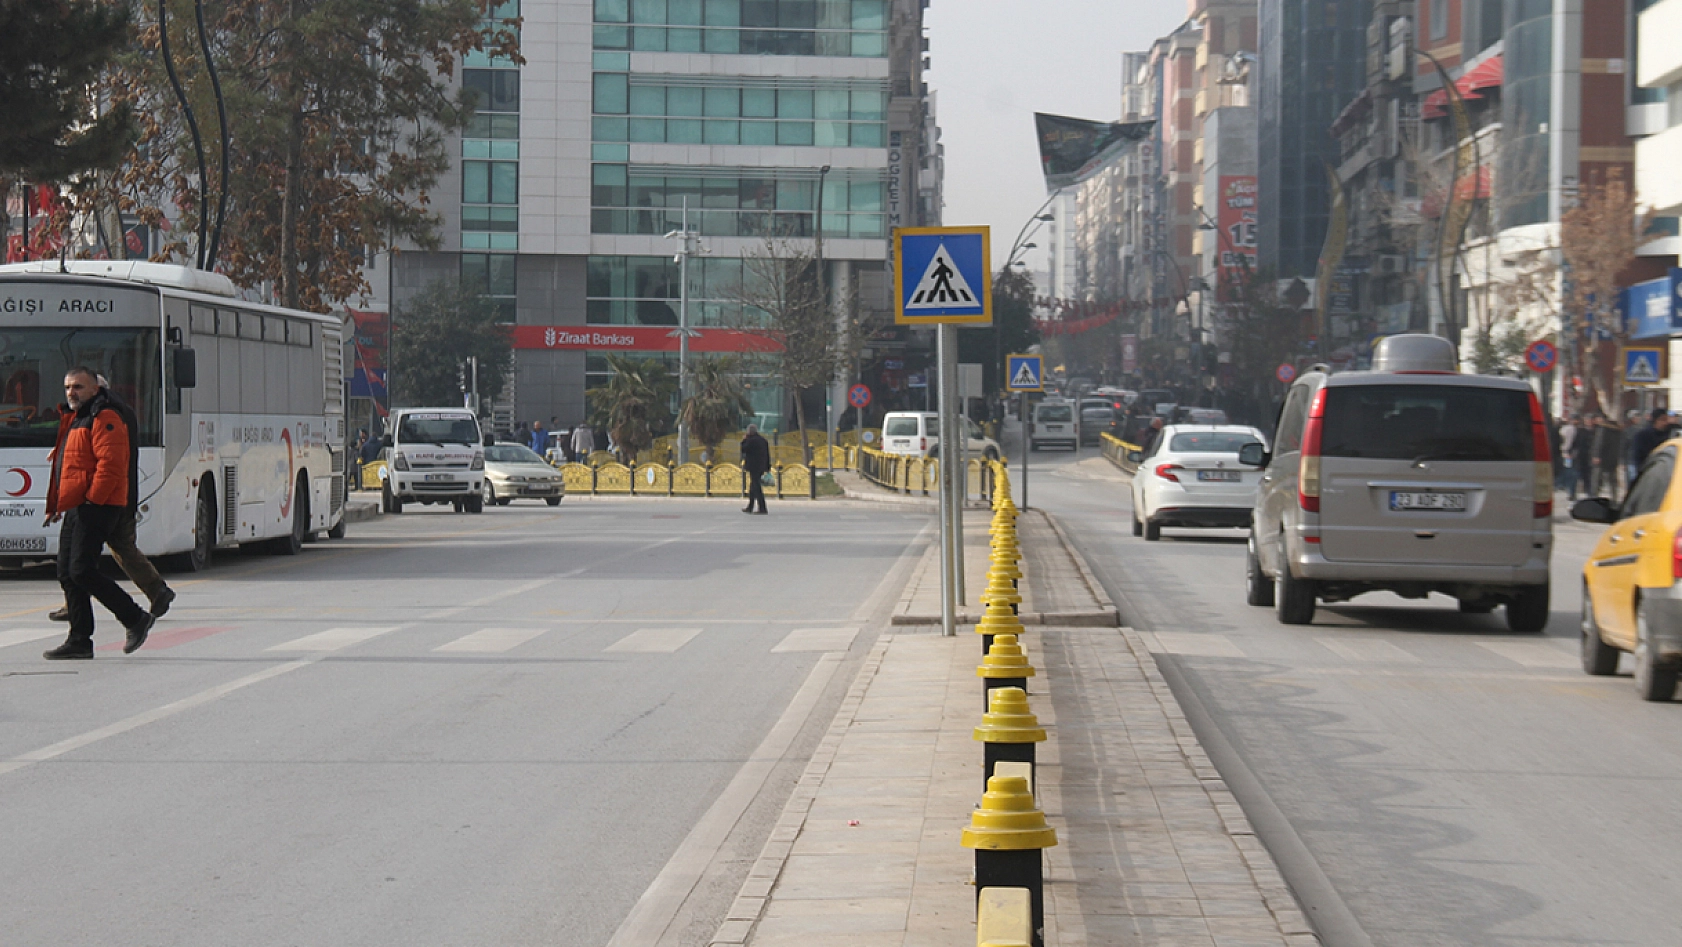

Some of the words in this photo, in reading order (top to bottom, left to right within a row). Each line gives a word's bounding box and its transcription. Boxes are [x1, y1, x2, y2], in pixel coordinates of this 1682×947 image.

[0, 297, 43, 316] ĞIŞI
[58, 299, 114, 313] ARACI
[558, 332, 591, 345] Ziraat
[593, 333, 635, 346] Bankası
